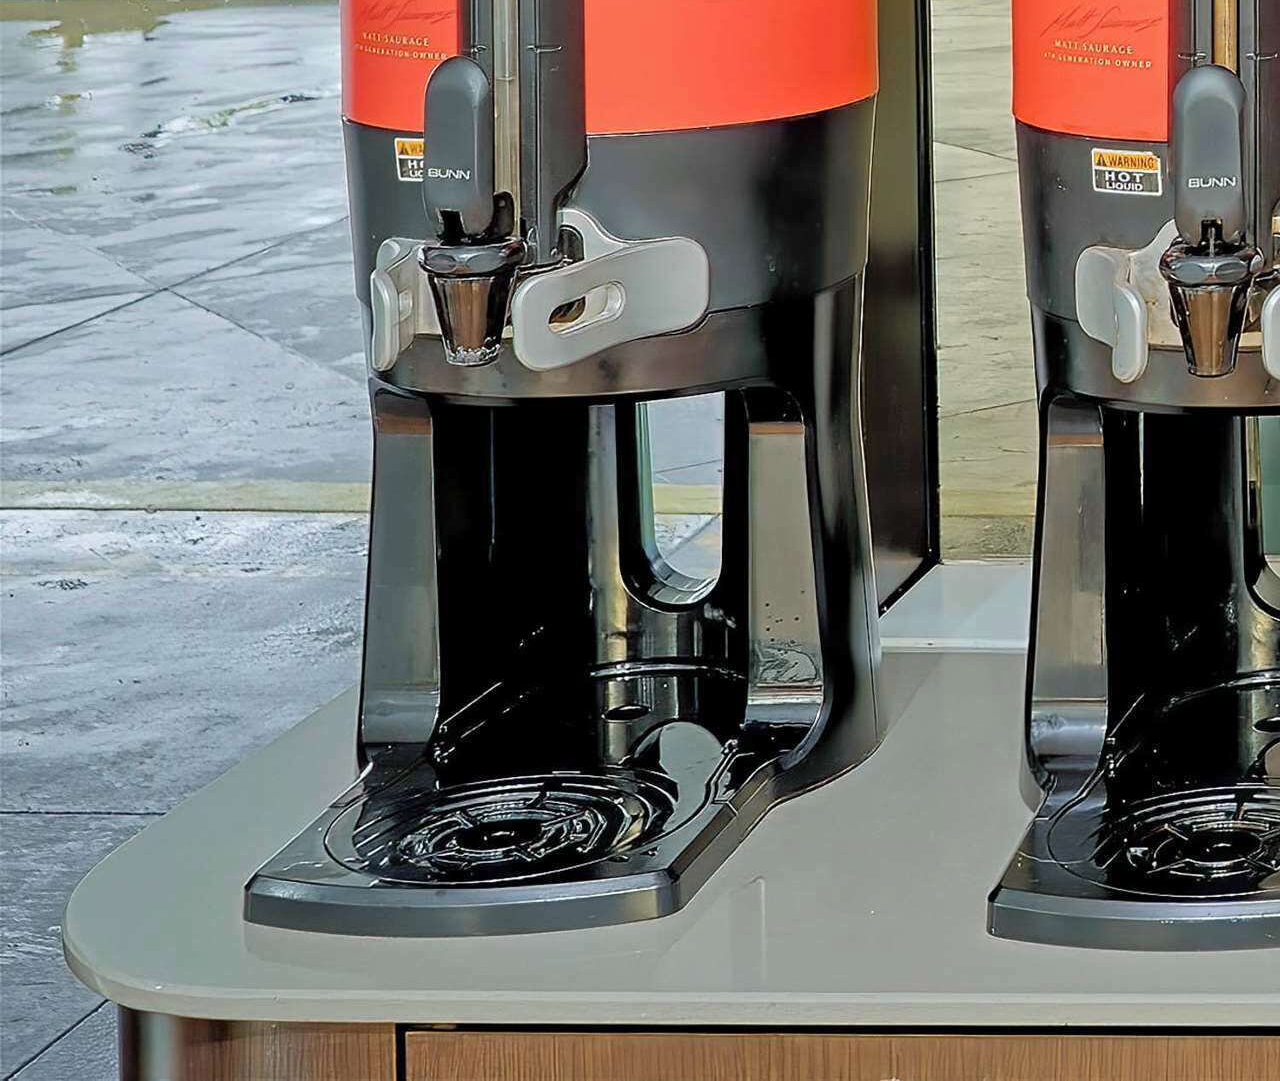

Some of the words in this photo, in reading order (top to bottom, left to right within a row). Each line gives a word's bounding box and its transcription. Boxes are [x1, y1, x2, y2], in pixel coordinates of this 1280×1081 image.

[383, 34, 430, 47] SAURAGE
[1054, 38, 1080, 51] MATT
[1082, 41, 1134, 55] SAURAGE
[1114, 58, 1153, 69] OWNER
[1107, 154, 1156, 169] WARNING
[427, 168, 472, 181] BUNN
[1104, 170, 1145, 183] HOT
[1105, 181, 1144, 192] LIQUID
[1188, 175, 1238, 188] BUNN
